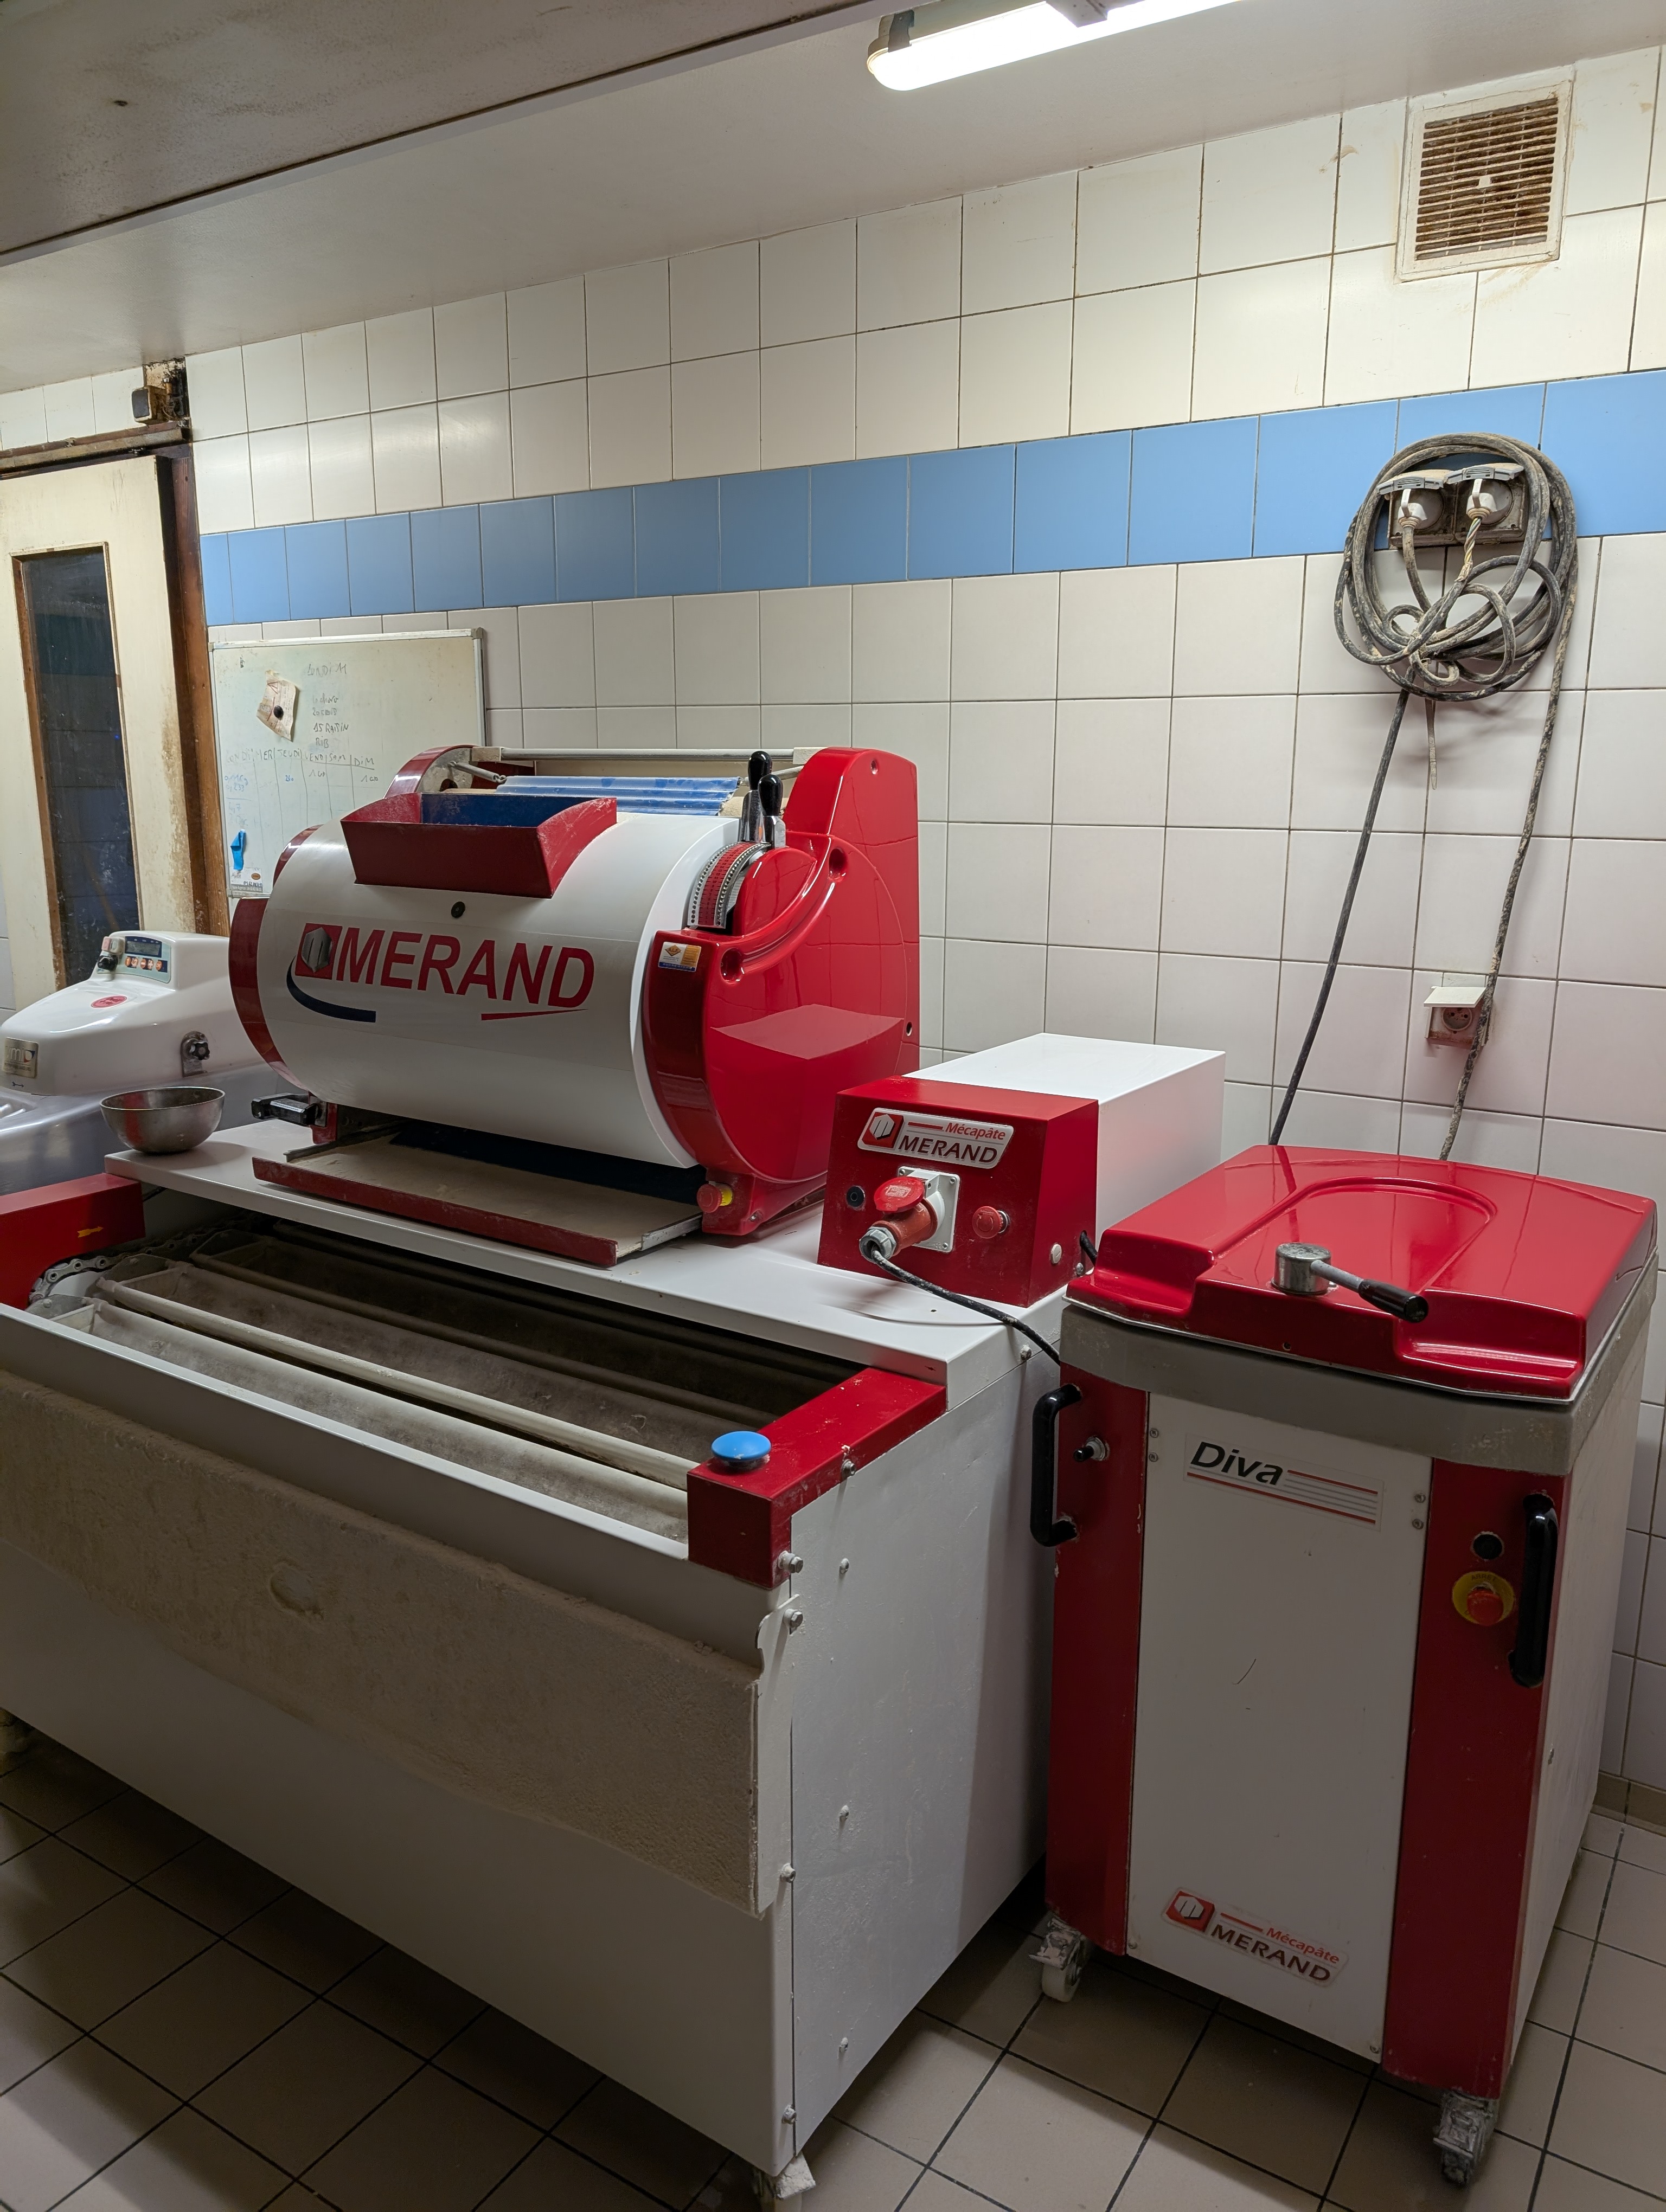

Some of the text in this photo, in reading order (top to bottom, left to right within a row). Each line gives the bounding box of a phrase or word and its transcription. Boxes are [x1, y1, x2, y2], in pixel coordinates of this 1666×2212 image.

[313, 723, 324, 732] 15
[336, 927, 595, 1008] MERAND
[898, 1135, 997, 1163] MERAND
[945, 1122, 1006, 1140] Mécapâte
[1190, 1442, 1283, 1486] Diva
[1211, 1924, 1330, 1980] MERAND
[1266, 1927, 1340, 1964] Mécapâte
